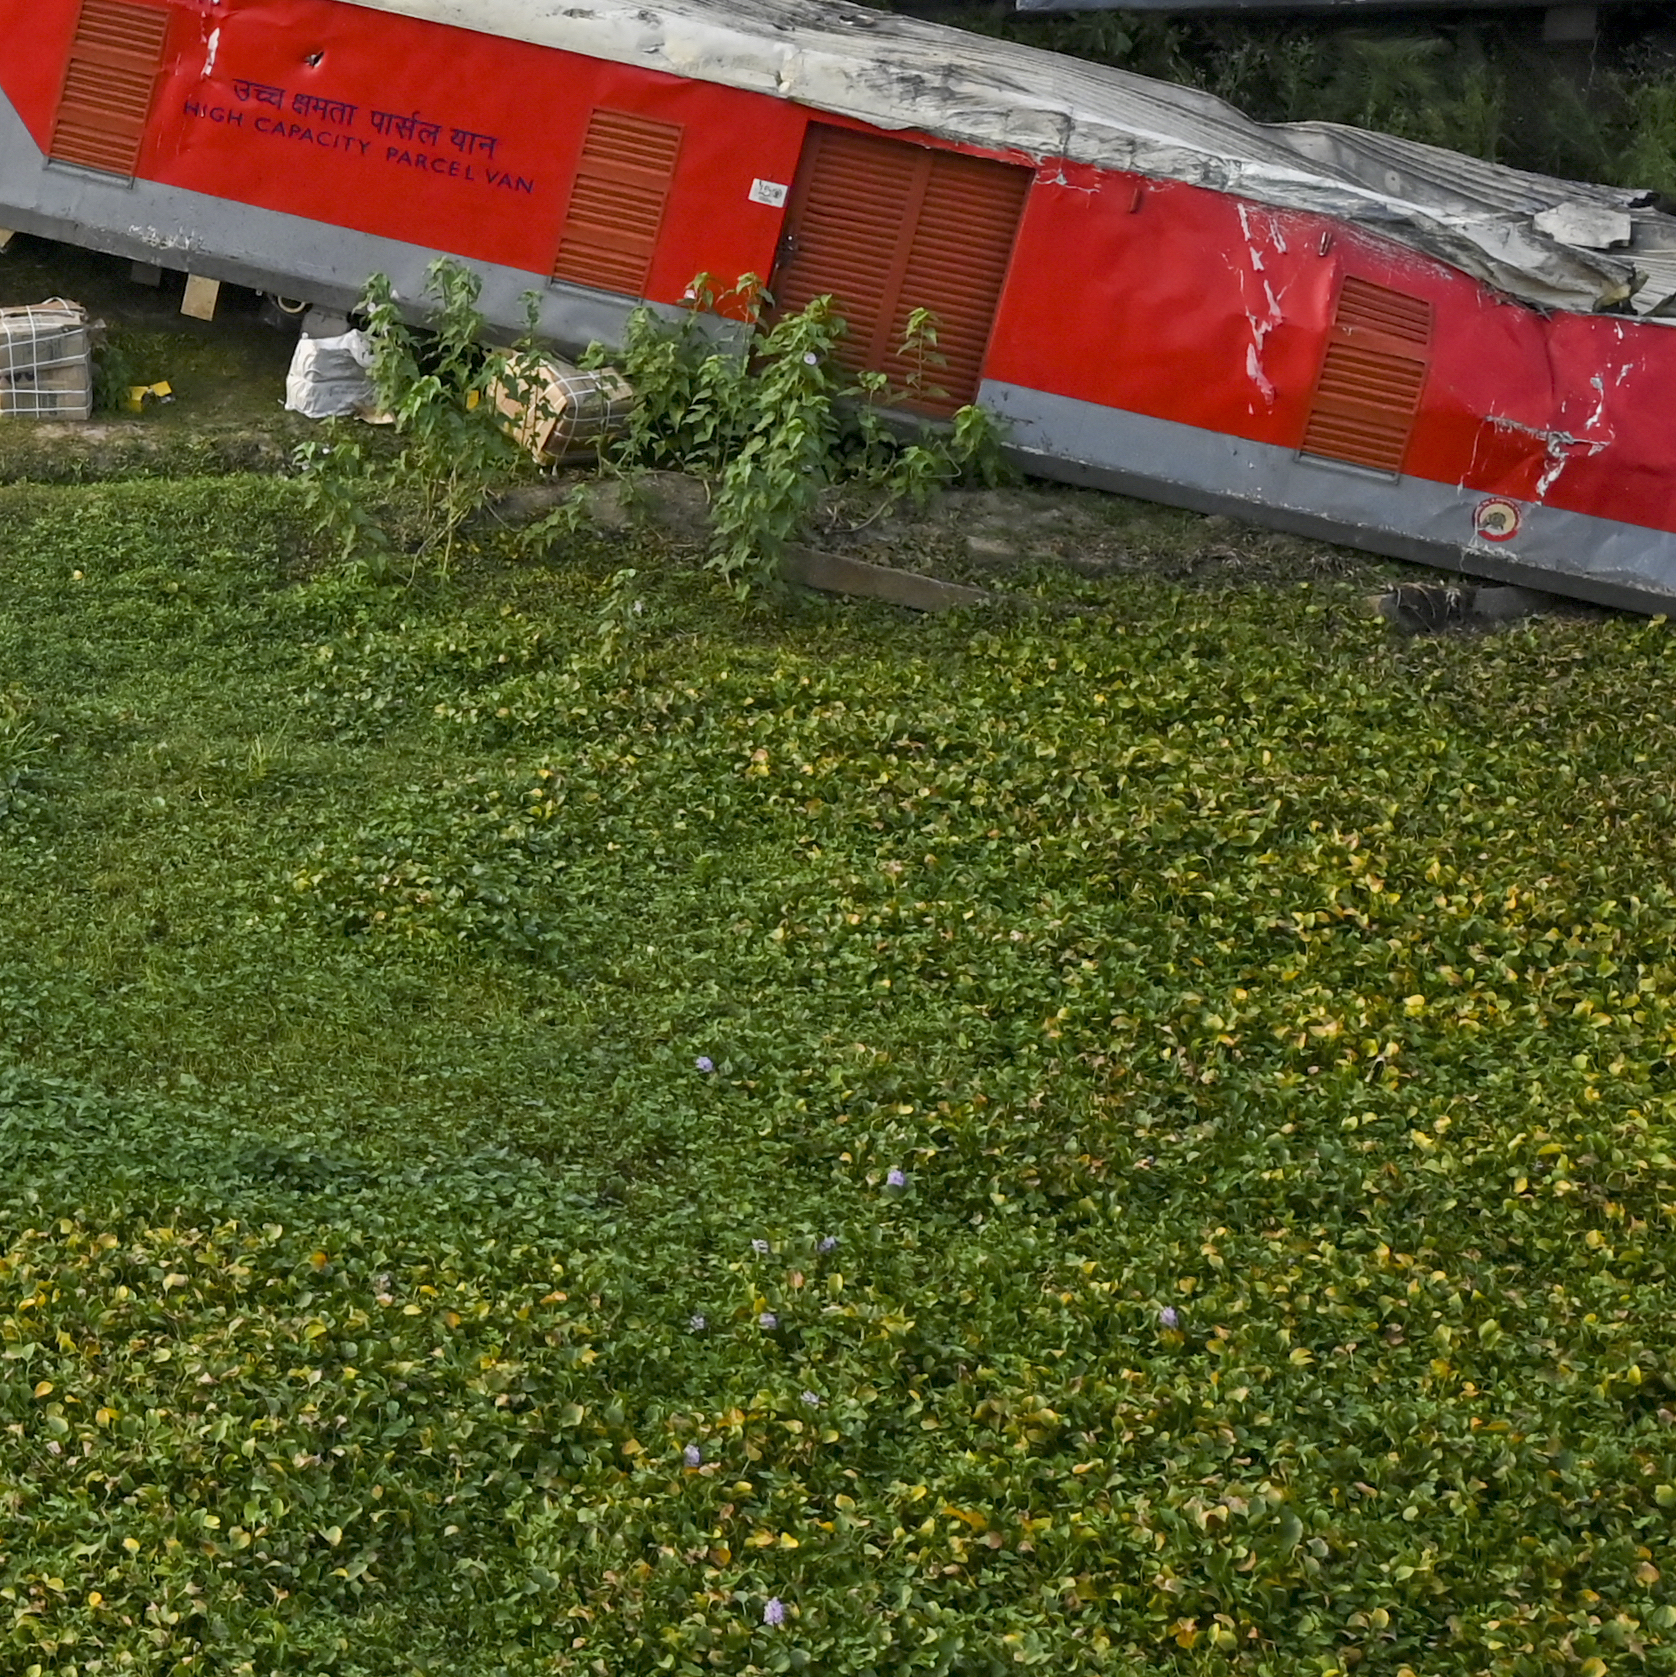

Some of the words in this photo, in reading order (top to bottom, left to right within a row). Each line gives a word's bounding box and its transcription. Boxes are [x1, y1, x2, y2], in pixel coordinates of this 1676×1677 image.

[184, 100, 243, 127] HIGH
[255, 117, 371, 154] CAPACITY
[387, 147, 475, 181] PARCEL
[485, 168, 535, 194] VAN
[233, 78, 286, 110] उच्च
[292, 93, 358, 126] क्षमता
[370, 110, 442, 146] पार्सल
[451, 128, 498, 159] यान
